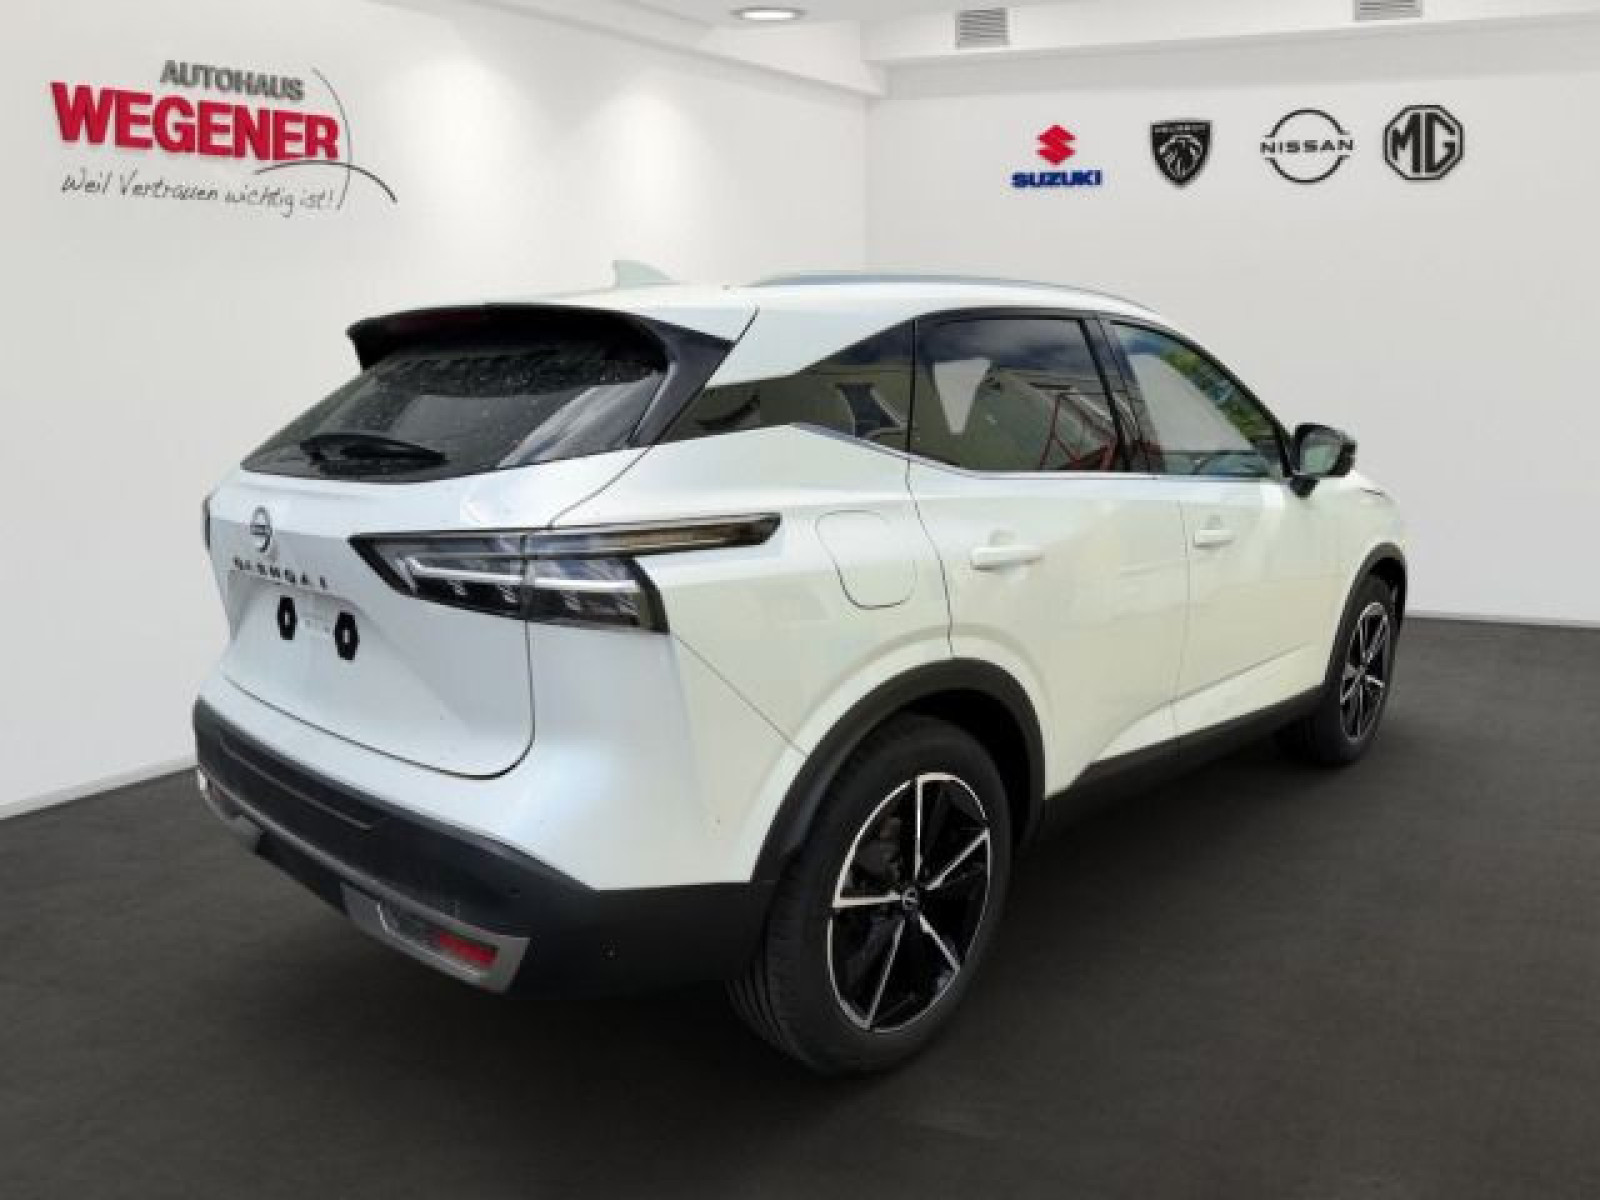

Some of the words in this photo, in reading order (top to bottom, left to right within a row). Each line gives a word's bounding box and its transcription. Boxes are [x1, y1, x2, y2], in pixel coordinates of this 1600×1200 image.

[160, 59, 305, 101] AUTOHAUS
[50, 81, 340, 162] WEGENER
[1391, 111, 1457, 175] MG
[1259, 138, 1354, 154] NISSAN
[61, 166, 113, 194] Weil
[119, 167, 219, 202] Vertrauen
[224, 183, 296, 218] wichtig
[1010, 168, 1103, 189] SUZUKI
